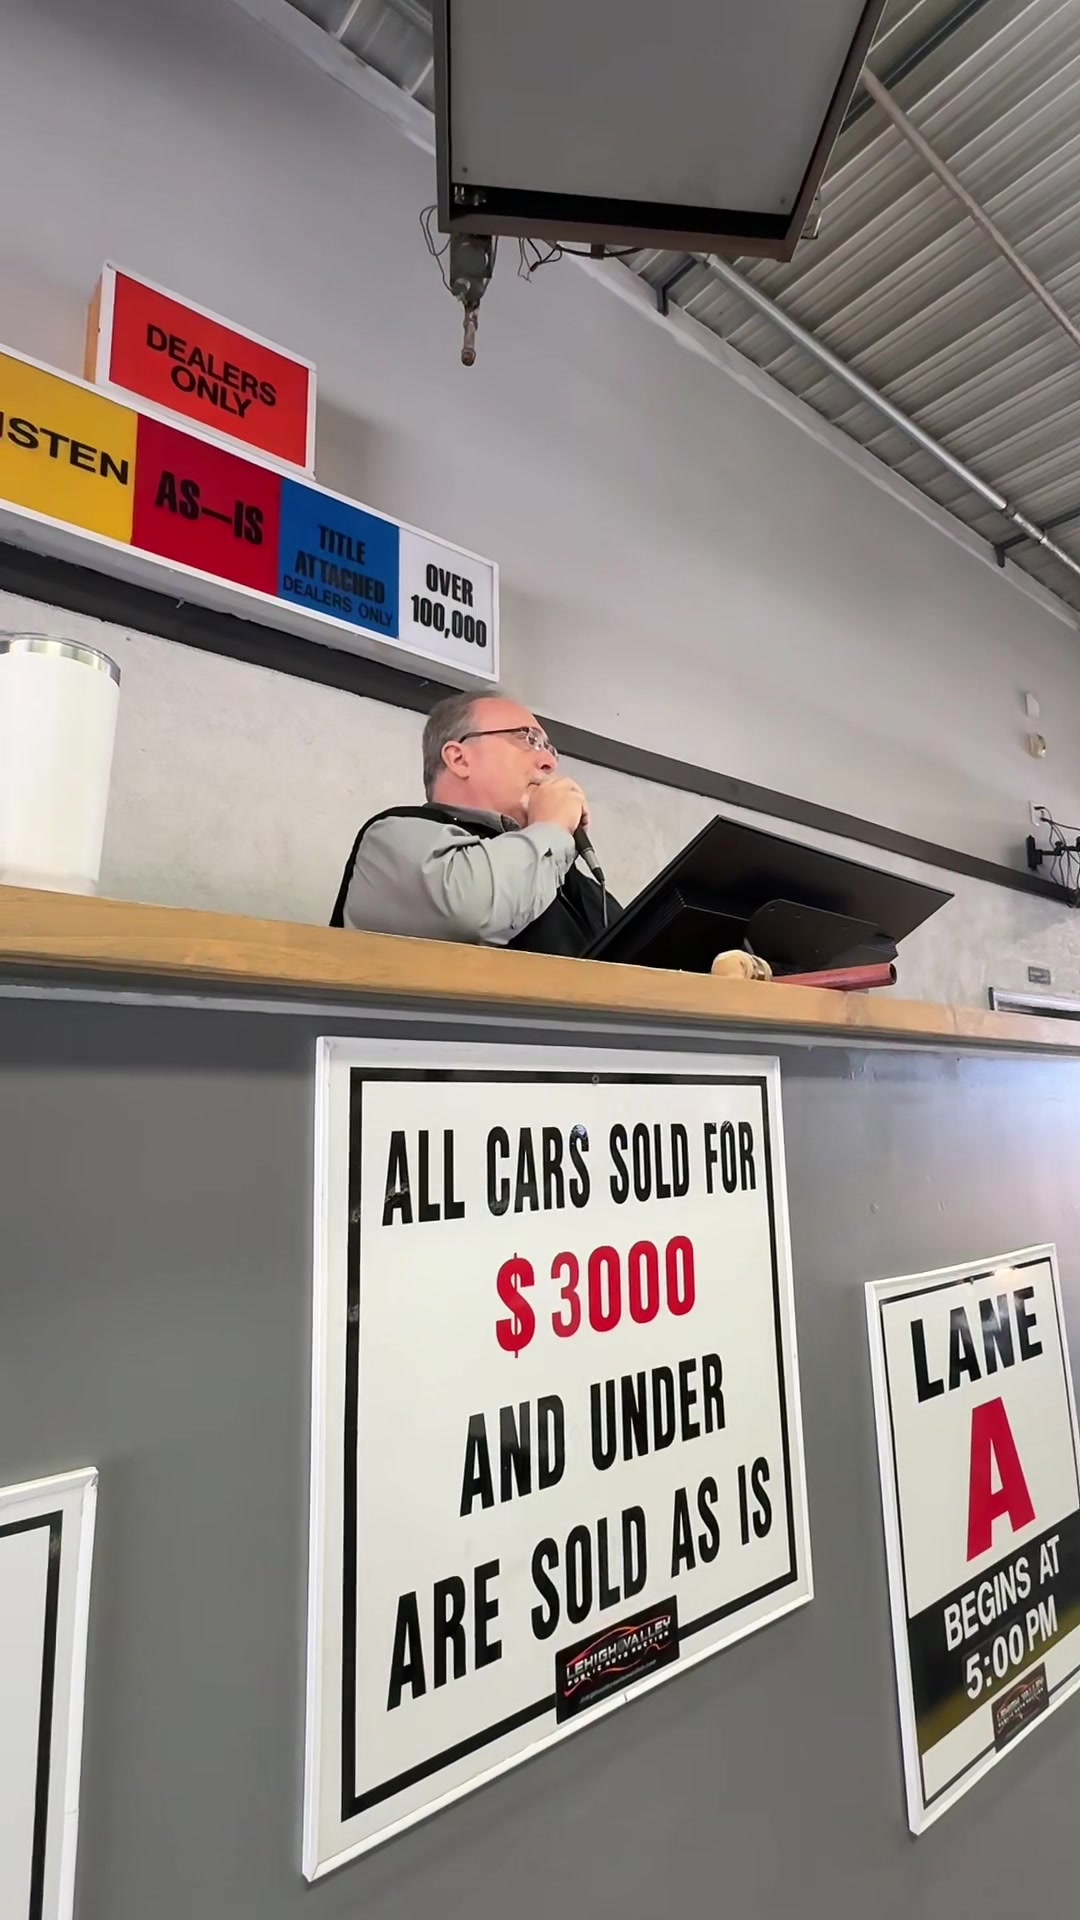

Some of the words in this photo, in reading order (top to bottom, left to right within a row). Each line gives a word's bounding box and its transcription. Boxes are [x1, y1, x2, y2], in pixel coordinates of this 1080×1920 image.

[147, 323, 277, 407] DEALERS
[171, 365, 252, 418] ONLY
[295, 550, 385, 604] ATTACHED
[319, 525, 366, 565] TITLE
[283, 575, 352, 613] DEALERS
[358, 604, 393, 628] ONLY
[411, 594, 487, 648] 100,000
[426, 563, 473, 607] OVER
[381, 1129, 465, 1226] ALL
[486, 1124, 590, 1216] CARS
[609, 1123, 689, 1204] SOLD
[704, 1120, 756, 1194] FOR
[910, 1286, 1043, 1403] LANE
[459, 1394, 565, 1517] AND
[590, 1353, 726, 1471] UNDER
[967, 1396, 1036, 1562] A
[386, 1558, 502, 1712] ARE
[531, 1505, 647, 1640] SOLD
[671, 1476, 720, 1578] AS
[737, 1456, 772, 1546] IS
[943, 1557, 1031, 1651] BEGINS
[1040, 1534, 1060, 1584] AT
[567, 1643, 617, 1679] LEHIGH
[623, 1616, 671, 1649] VALLEY
